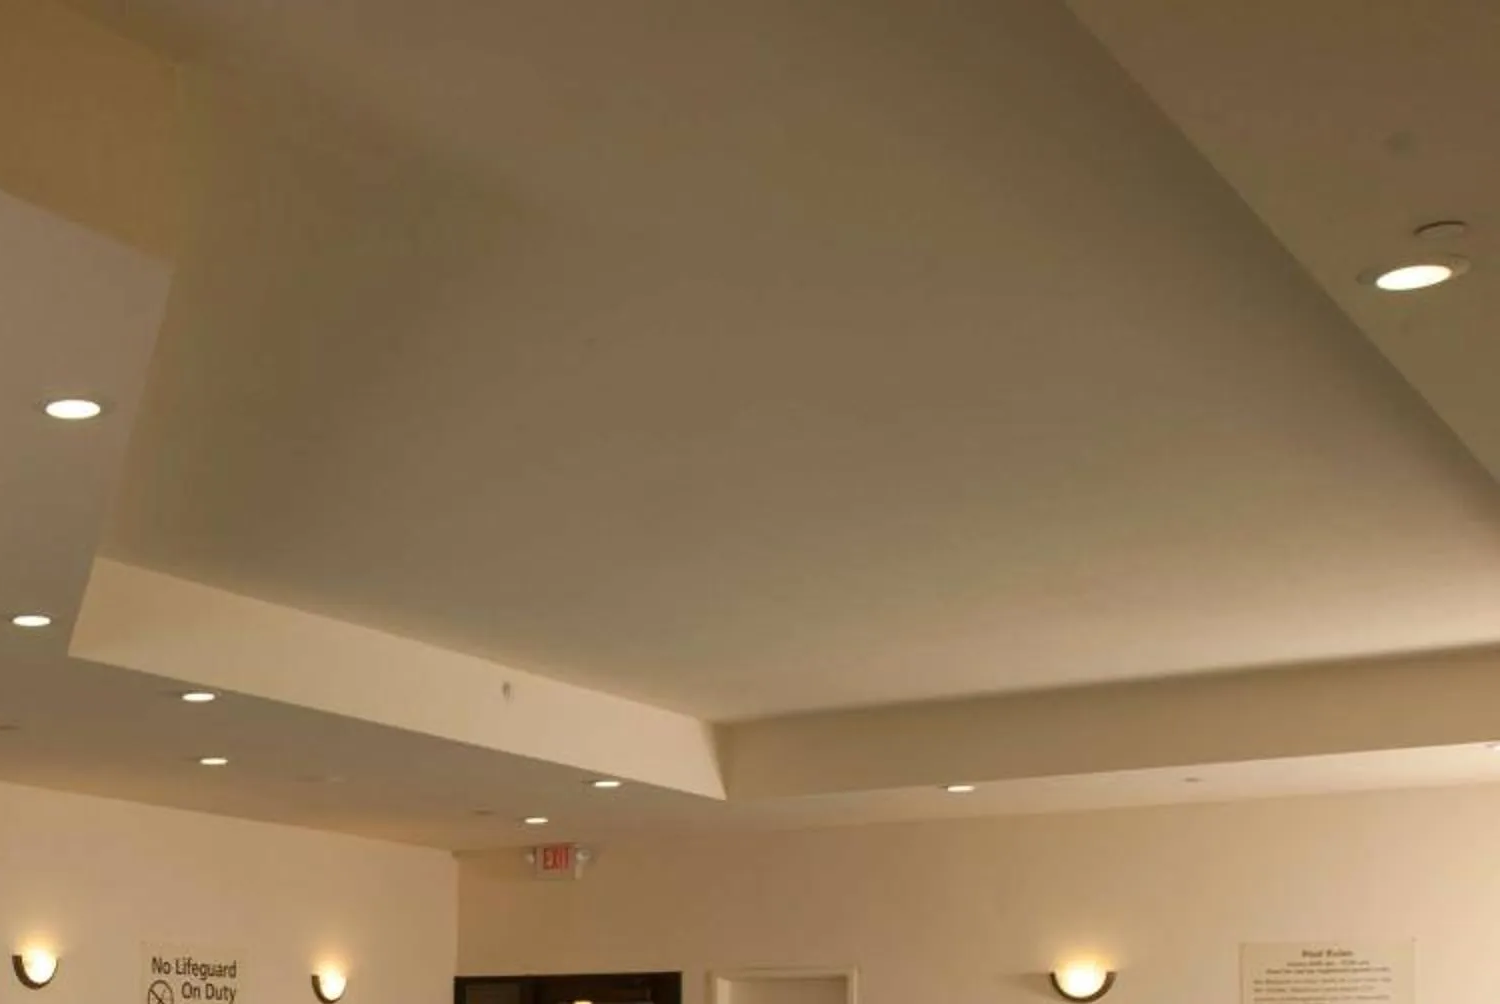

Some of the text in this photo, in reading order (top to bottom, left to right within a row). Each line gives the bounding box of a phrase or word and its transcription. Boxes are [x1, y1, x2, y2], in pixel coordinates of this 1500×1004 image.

[151, 956, 237, 981] No Lifeguard
[181, 981, 201, 1000] On
